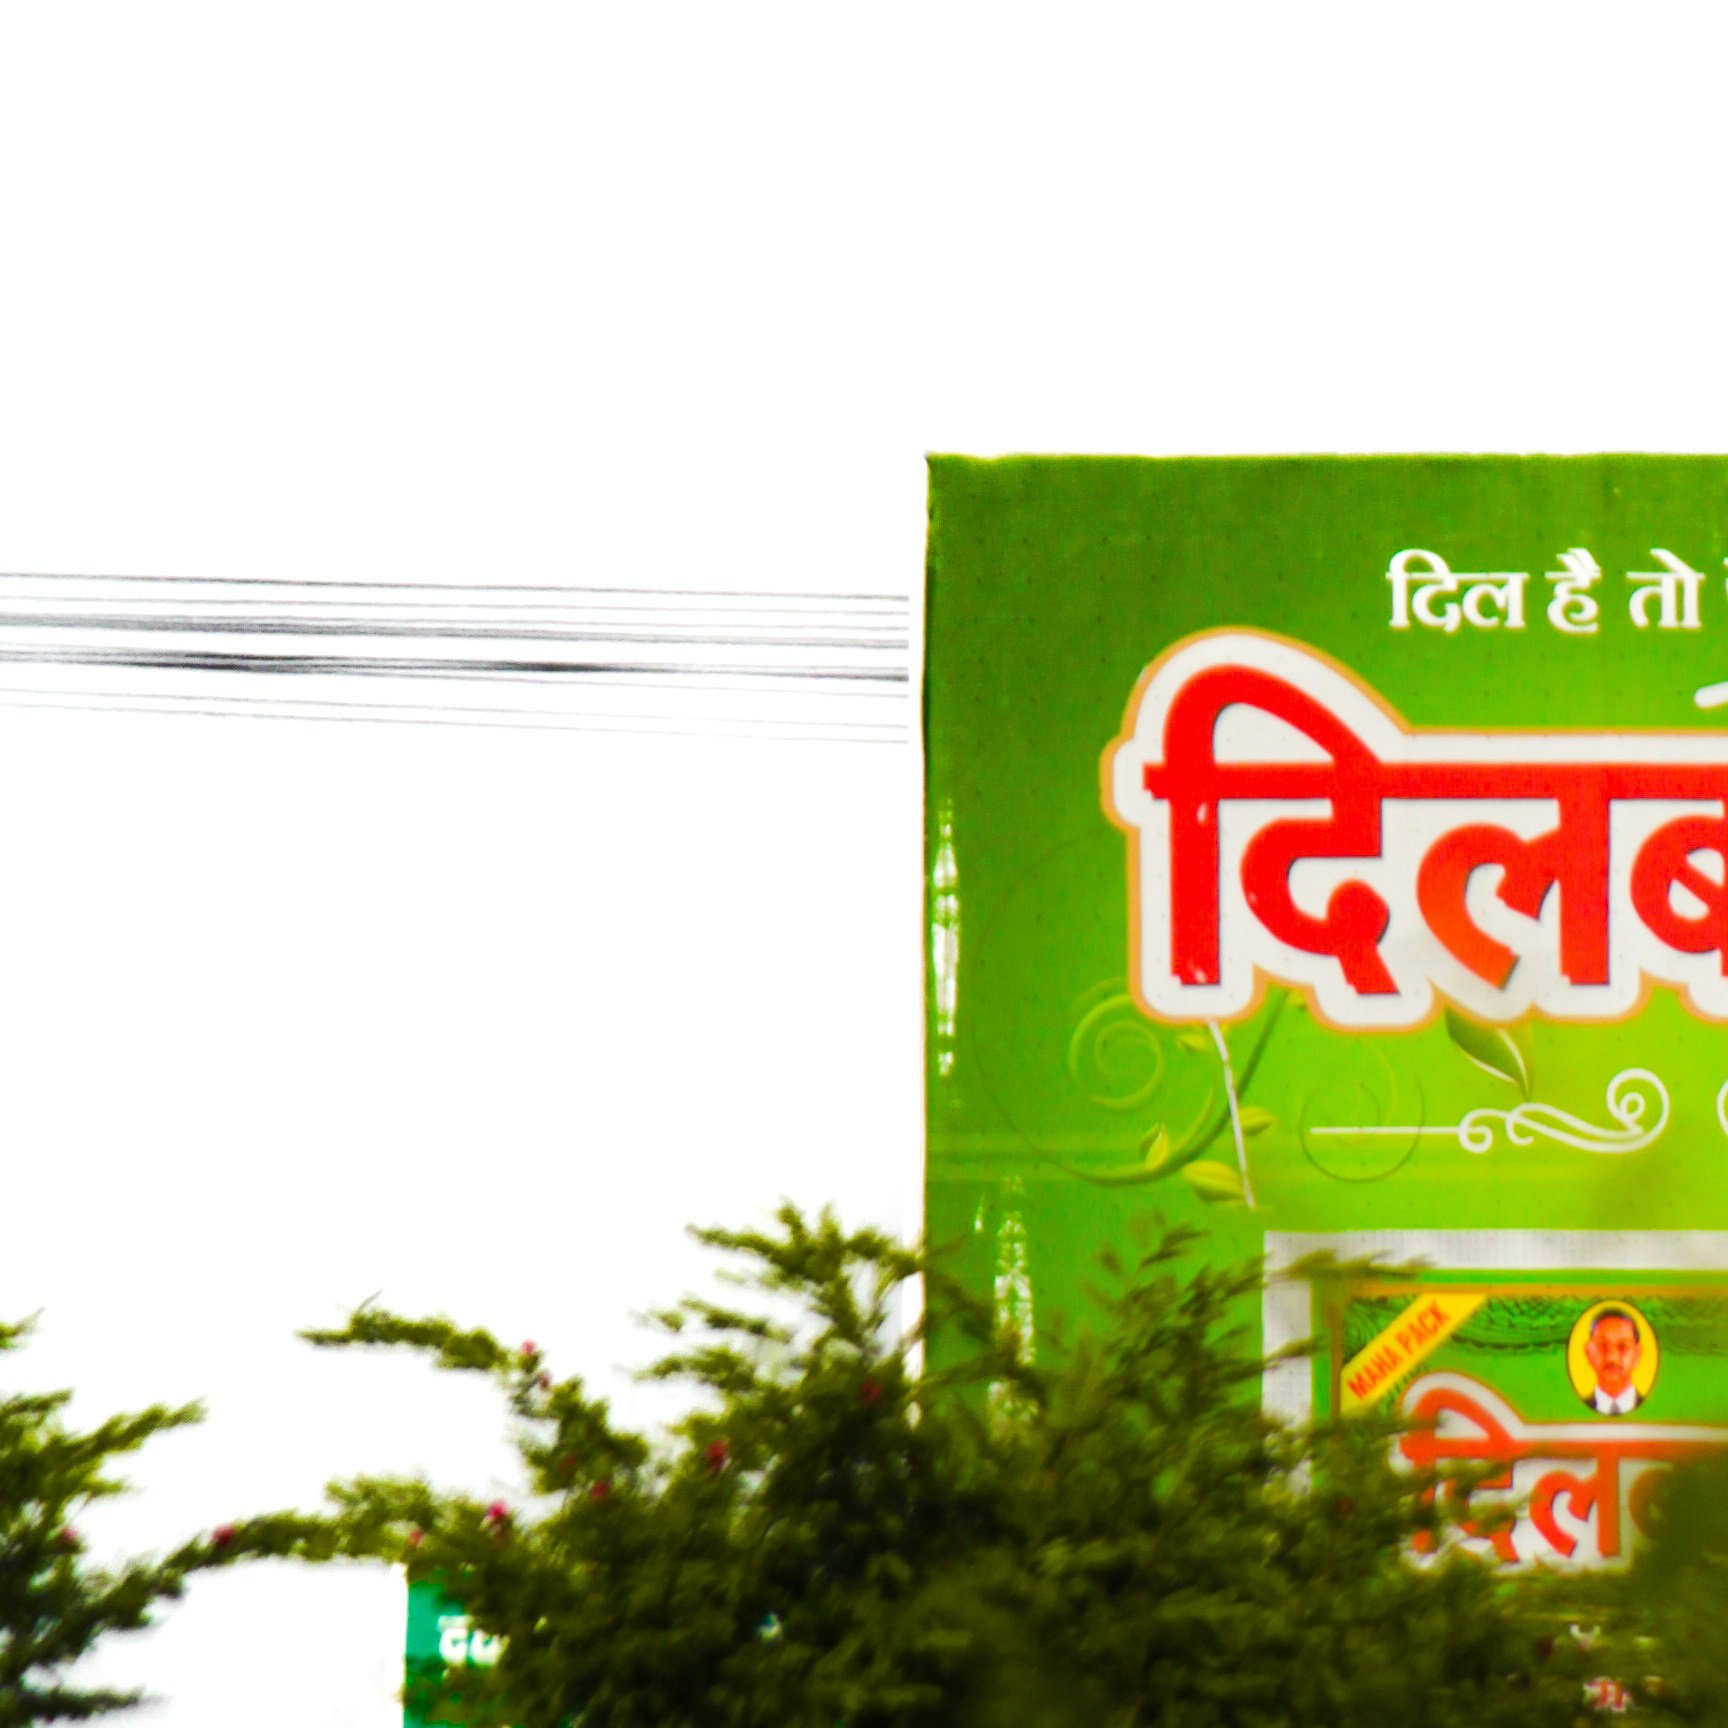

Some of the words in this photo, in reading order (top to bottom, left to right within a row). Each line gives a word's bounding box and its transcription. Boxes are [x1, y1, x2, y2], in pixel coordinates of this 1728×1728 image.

[1385, 547, 1530, 633] दिल
[1544, 547, 1602, 633] है
[1626, 547, 1705, 629] तो
[1346, 1345, 1404, 1402] MAHA
[1394, 1298, 1450, 1355] PACK
